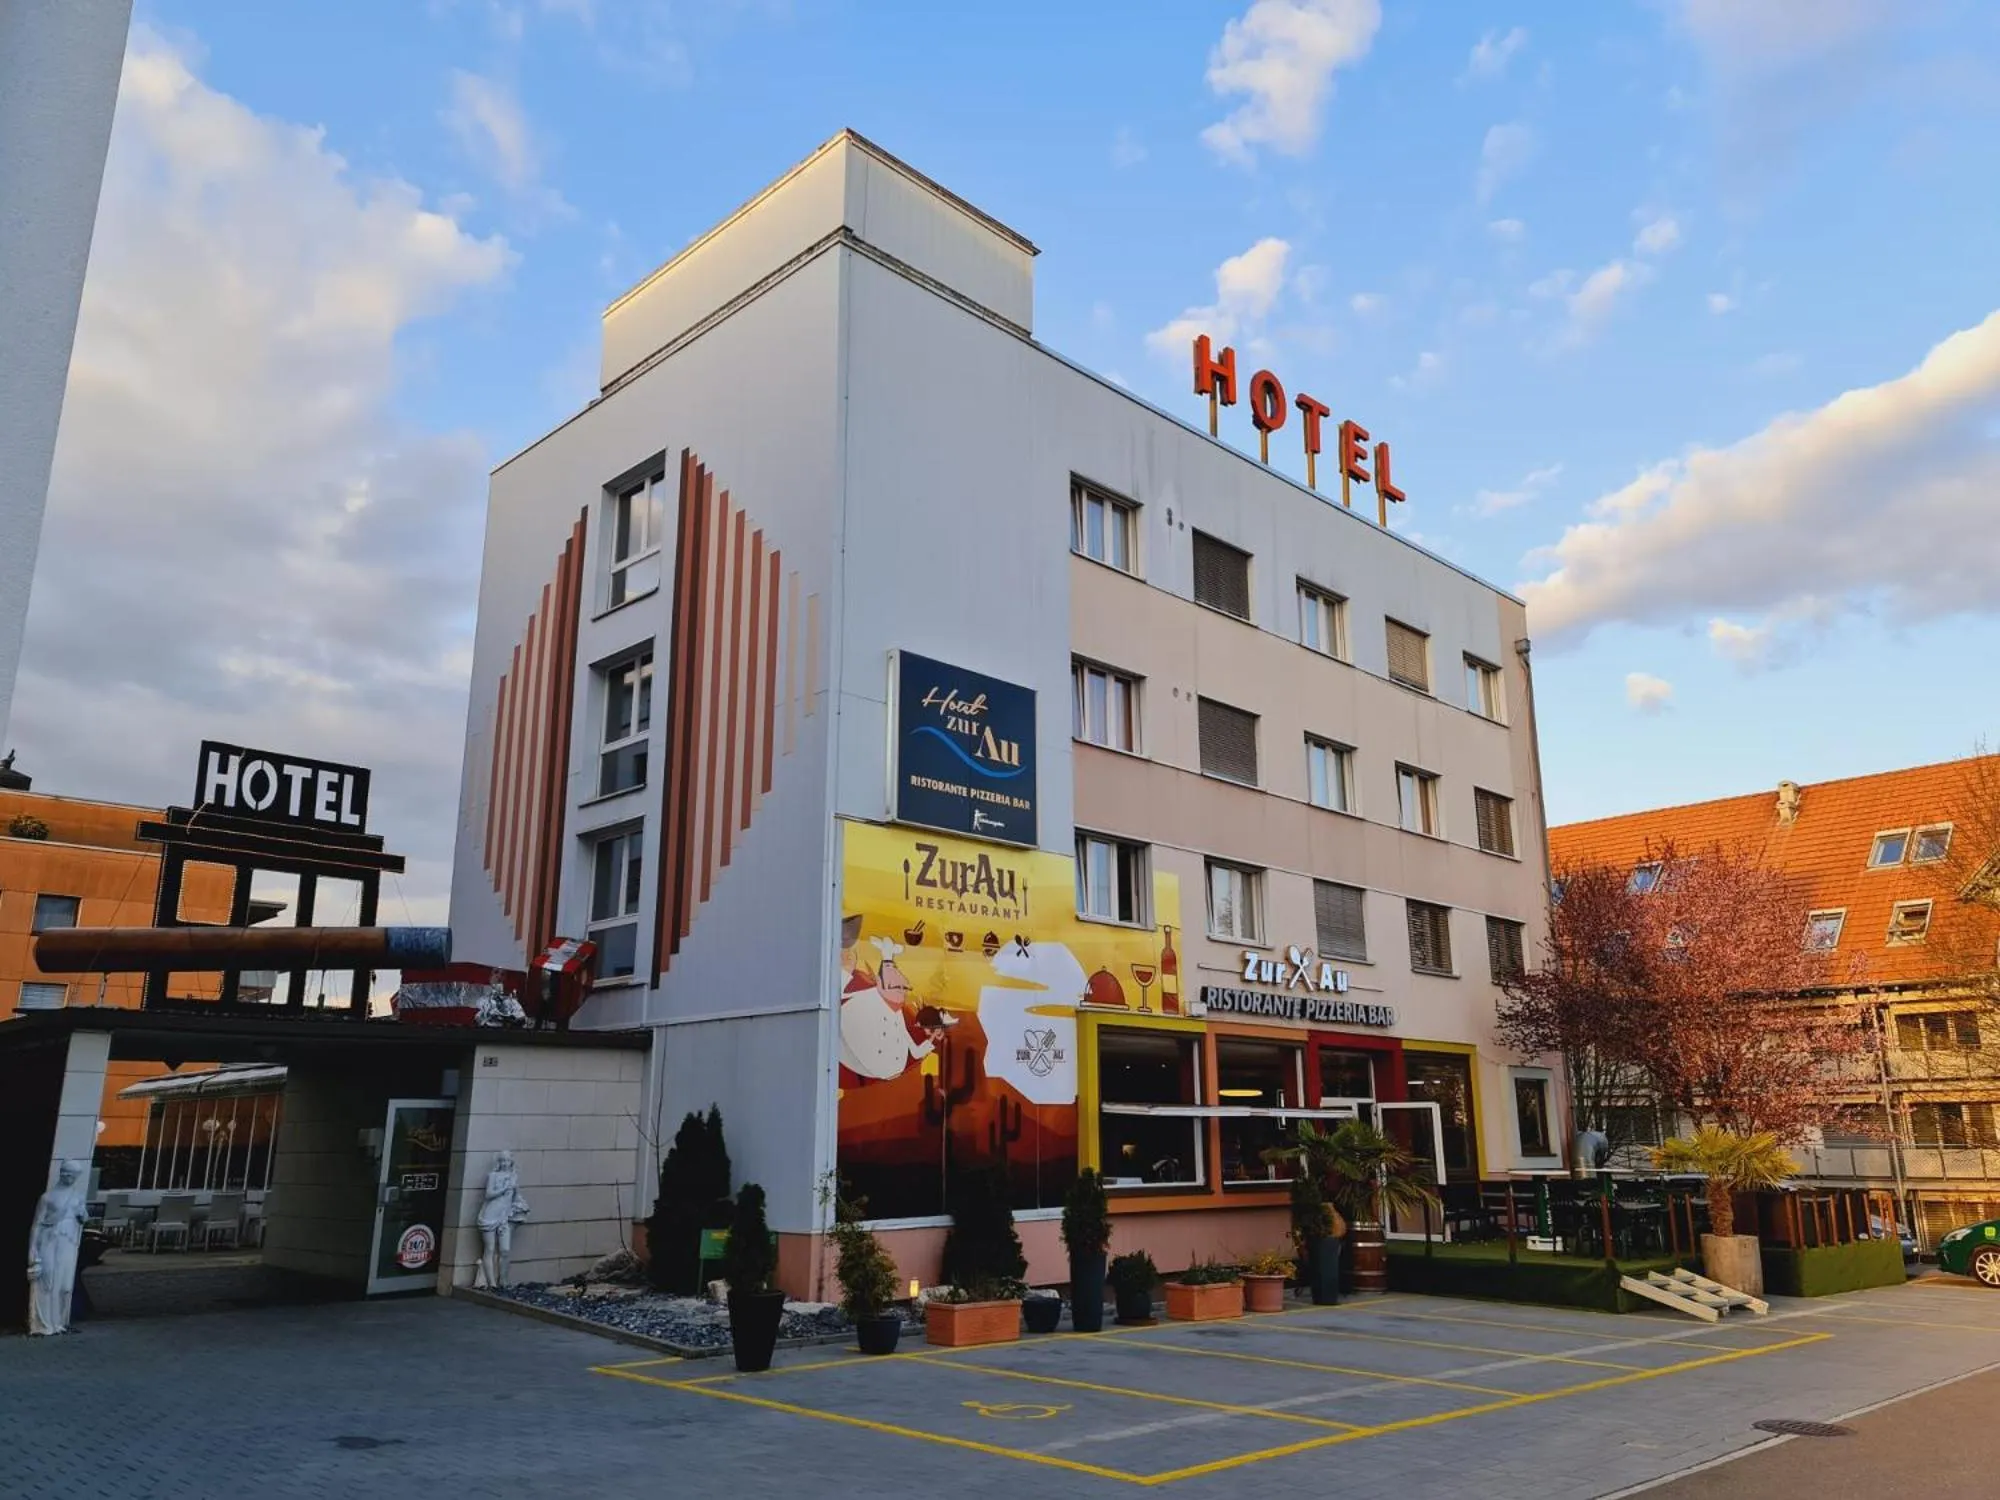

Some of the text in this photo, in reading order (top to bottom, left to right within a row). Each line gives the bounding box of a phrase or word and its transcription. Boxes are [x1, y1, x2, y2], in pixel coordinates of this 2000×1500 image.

[1193, 334, 1406, 502] HOTEL
[921, 686, 988, 715] Hotel
[946, 715, 1021, 766] zur Au
[203, 751, 361, 825] HOTEL
[910, 775, 1031, 810] RISTORANTE PIZZERIA BAR
[915, 895, 1022, 921] RESTAURANT
[1242, 950, 1350, 993] Zur Au
[1205, 987, 1395, 1027] RISTORANTE PIZZERIA BAR
